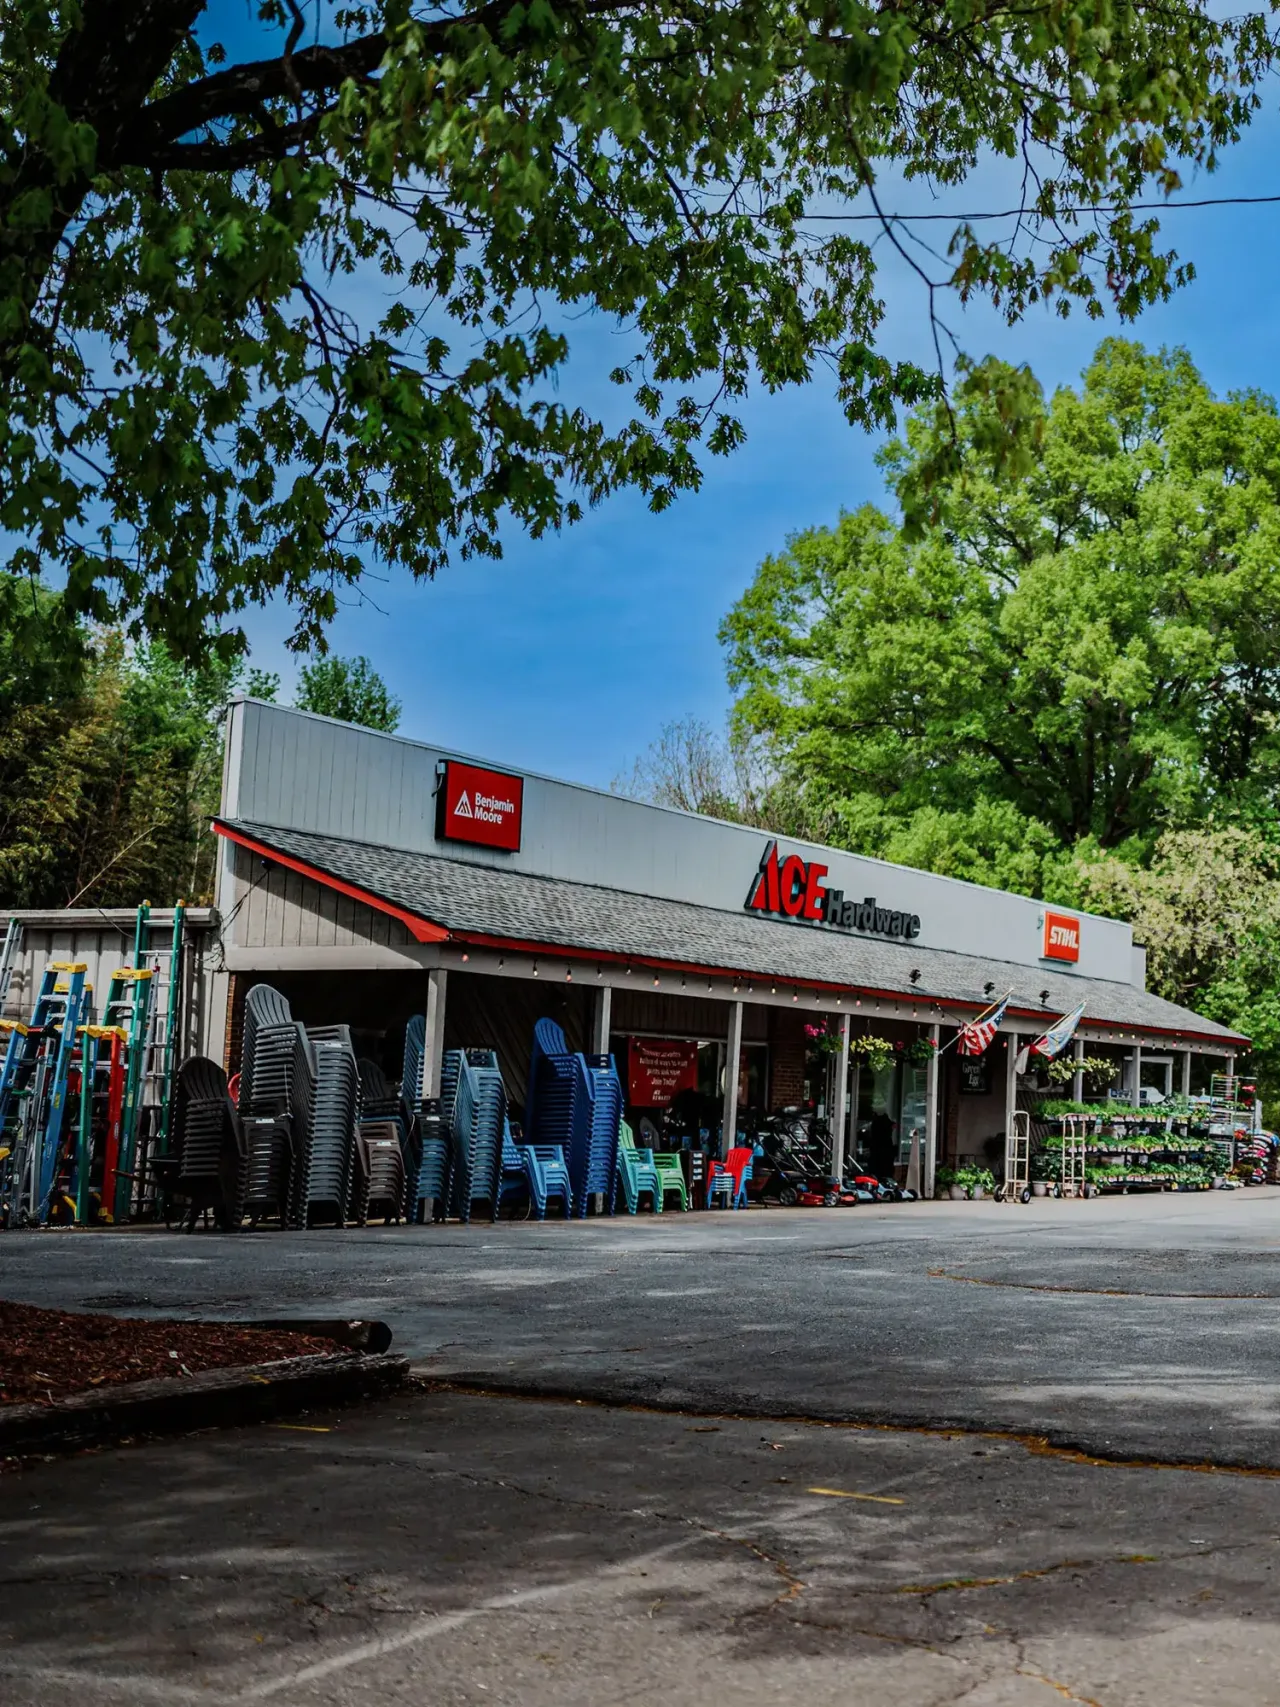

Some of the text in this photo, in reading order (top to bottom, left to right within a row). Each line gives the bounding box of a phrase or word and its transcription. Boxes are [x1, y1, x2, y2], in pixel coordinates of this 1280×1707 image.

[475, 792, 515, 813] Benjamin
[474, 806, 503, 824] Moore
[744, 839, 921, 939] ACE Hardware
[1049, 925, 1079, 949] STIHL
